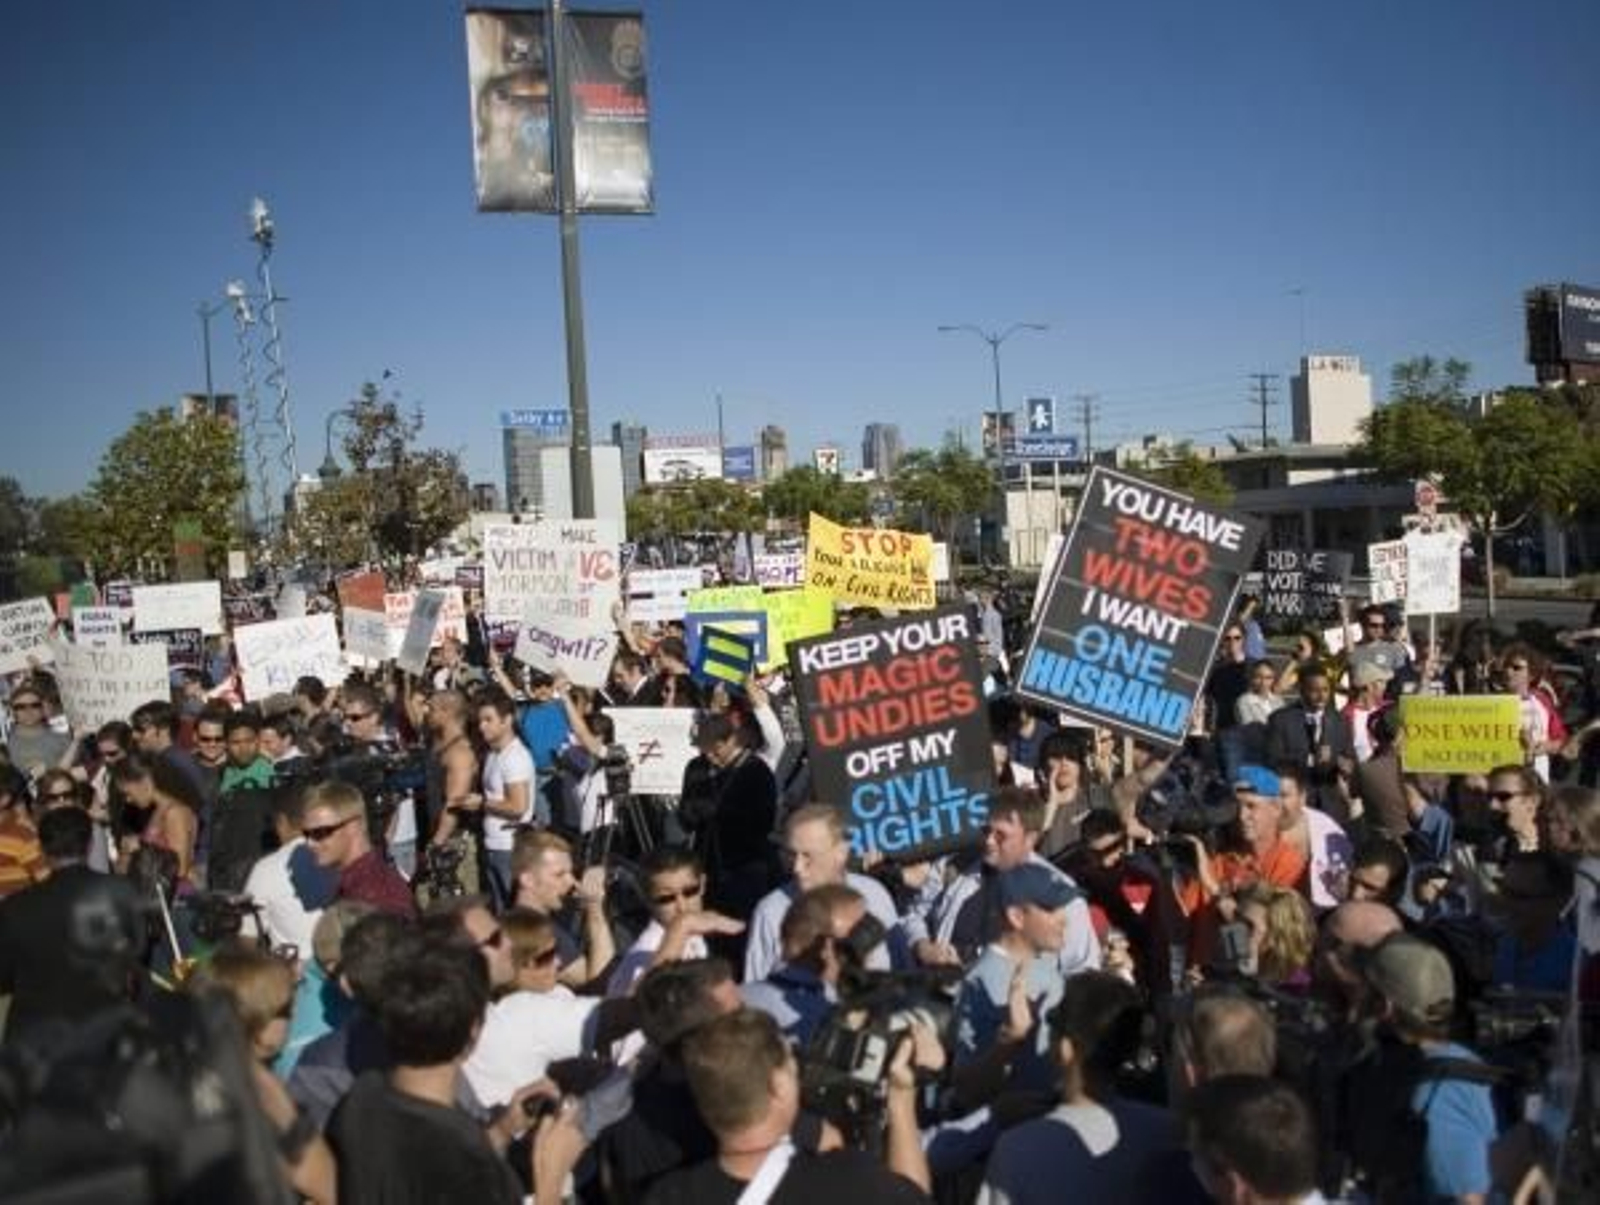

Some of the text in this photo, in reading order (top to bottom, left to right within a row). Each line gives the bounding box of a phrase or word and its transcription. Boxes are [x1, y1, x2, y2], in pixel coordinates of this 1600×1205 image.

[840, 531, 913, 558] STOP
[1101, 479, 1245, 550] YOU HAVE
[1113, 517, 1209, 576] TWO
[1265, 550, 1298, 571] DID
[1083, 549, 1212, 619] WIVES
[799, 614, 969, 674] KEEP YOUR
[1081, 588, 1189, 643] I WANT
[818, 645, 962, 707] MAGIC
[1075, 624, 1173, 684] ONE
[812, 681, 980, 746] UNDIES
[1024, 648, 1194, 734] HUSBAND
[846, 729, 957, 779] OFF MY
[851, 766, 967, 819] CIVIL
